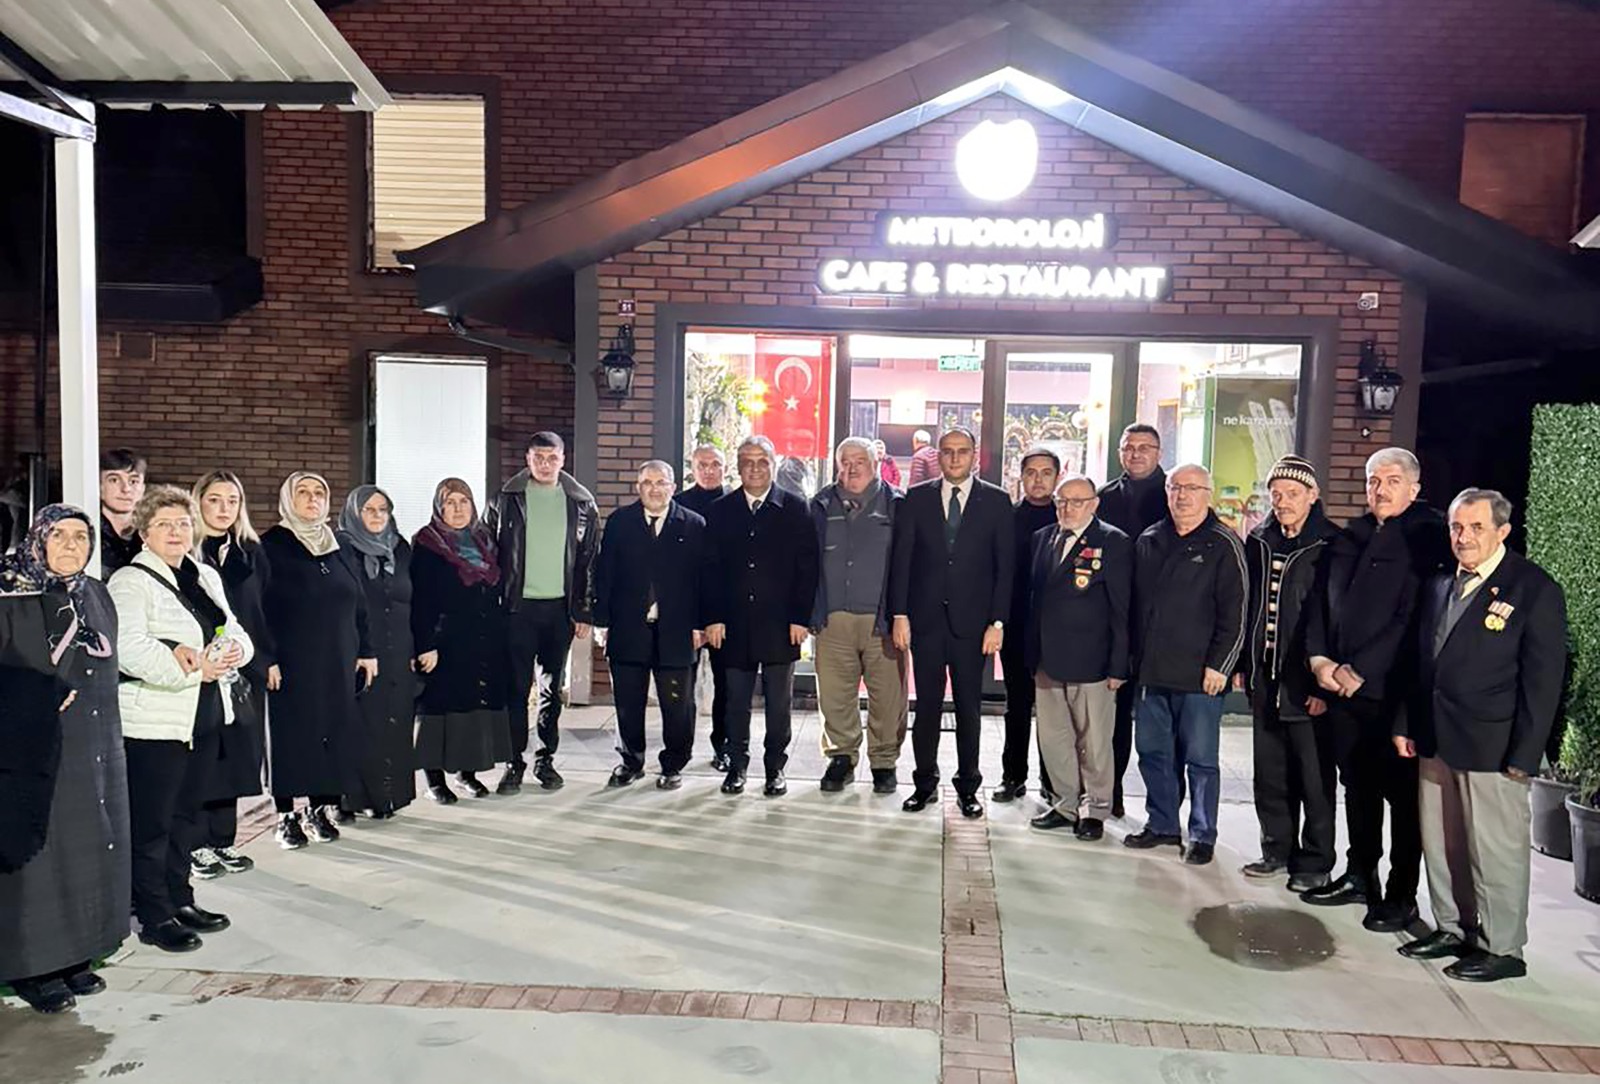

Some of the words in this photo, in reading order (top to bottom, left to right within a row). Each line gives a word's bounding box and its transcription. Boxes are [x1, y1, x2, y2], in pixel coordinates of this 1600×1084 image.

[823, 260, 907, 293] CAFE
[913, 262, 940, 293] &
[946, 264, 1165, 299] RESTAURANT
[1223, 416, 1238, 425] ne
